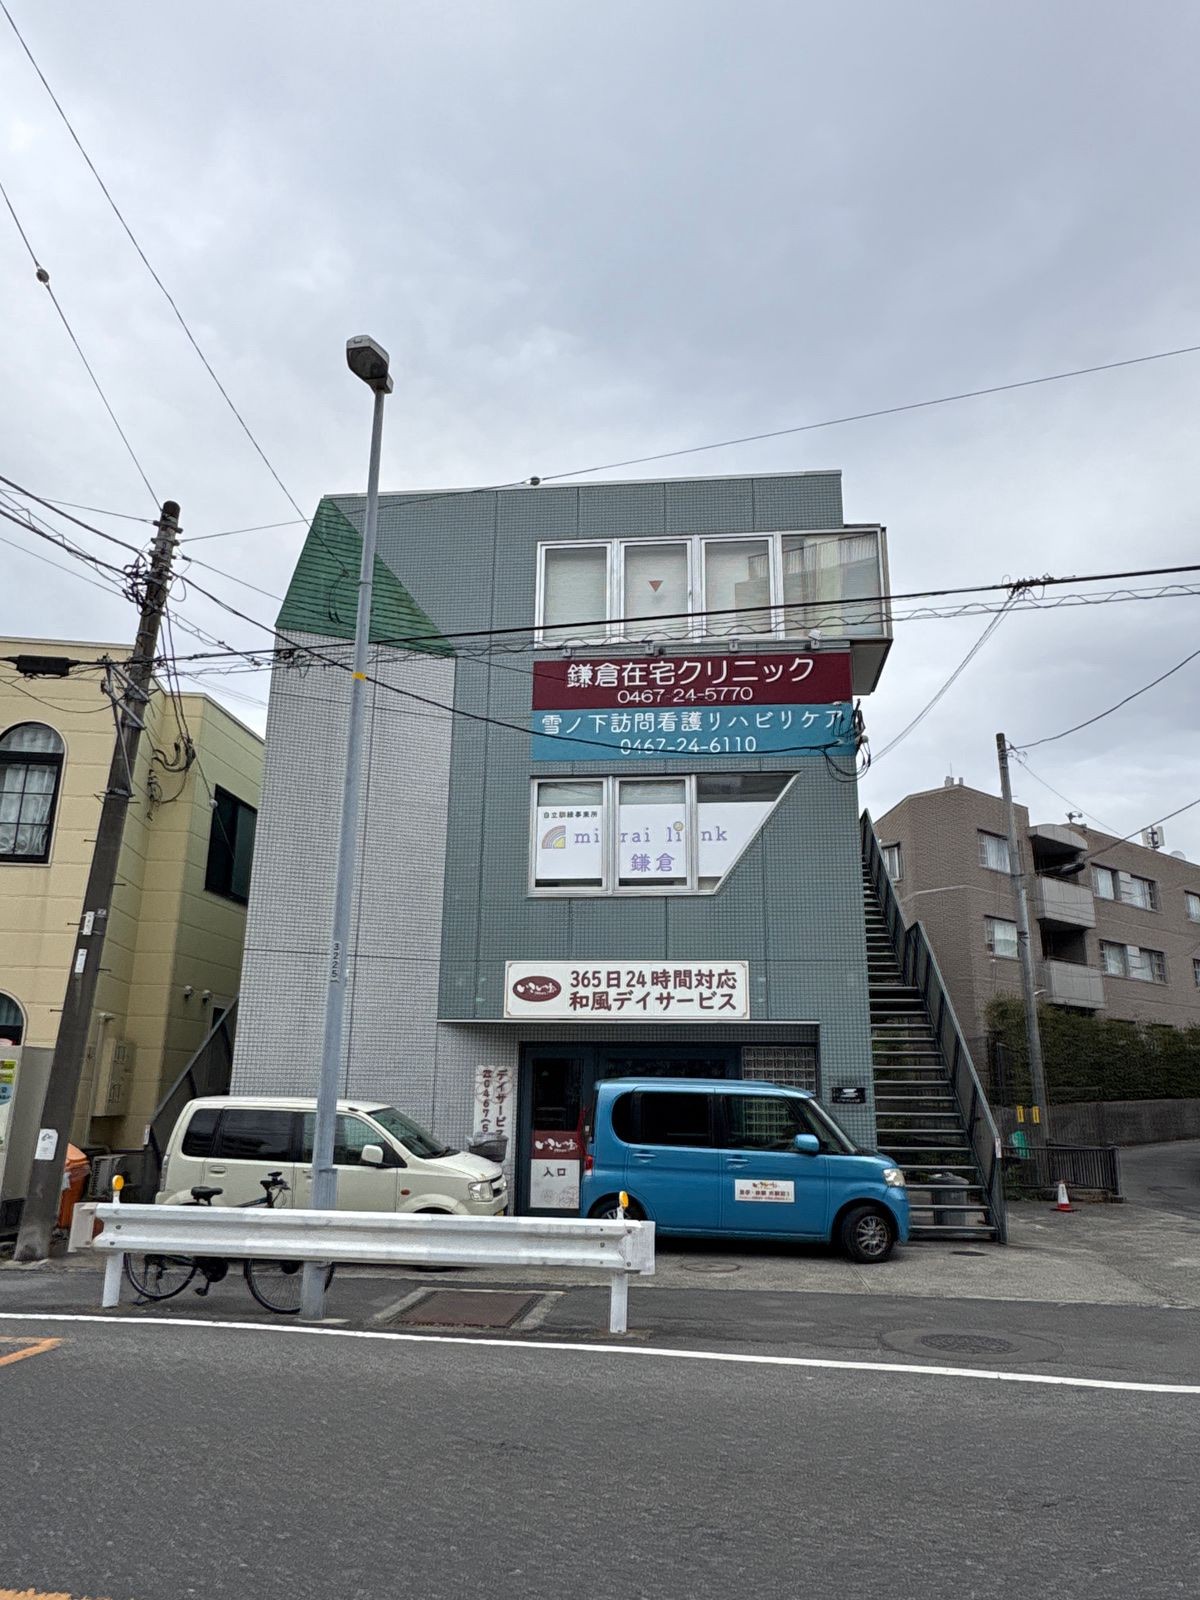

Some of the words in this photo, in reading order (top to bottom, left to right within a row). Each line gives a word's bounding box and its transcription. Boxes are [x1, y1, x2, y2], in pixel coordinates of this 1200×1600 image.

[567, 658, 814, 688] 鎌倉在宅クリニック
[541, 710, 843, 734] 雪ノ下訪問看護リハビリケア
[620, 735, 757, 755] 0467-24-6110
[631, 853, 675, 872] 鎌倉
[570, 969, 738, 989] 365日24時間対応
[569, 990, 738, 1011] 和風デイサービス
[543, 1166, 566, 1177] 入口
